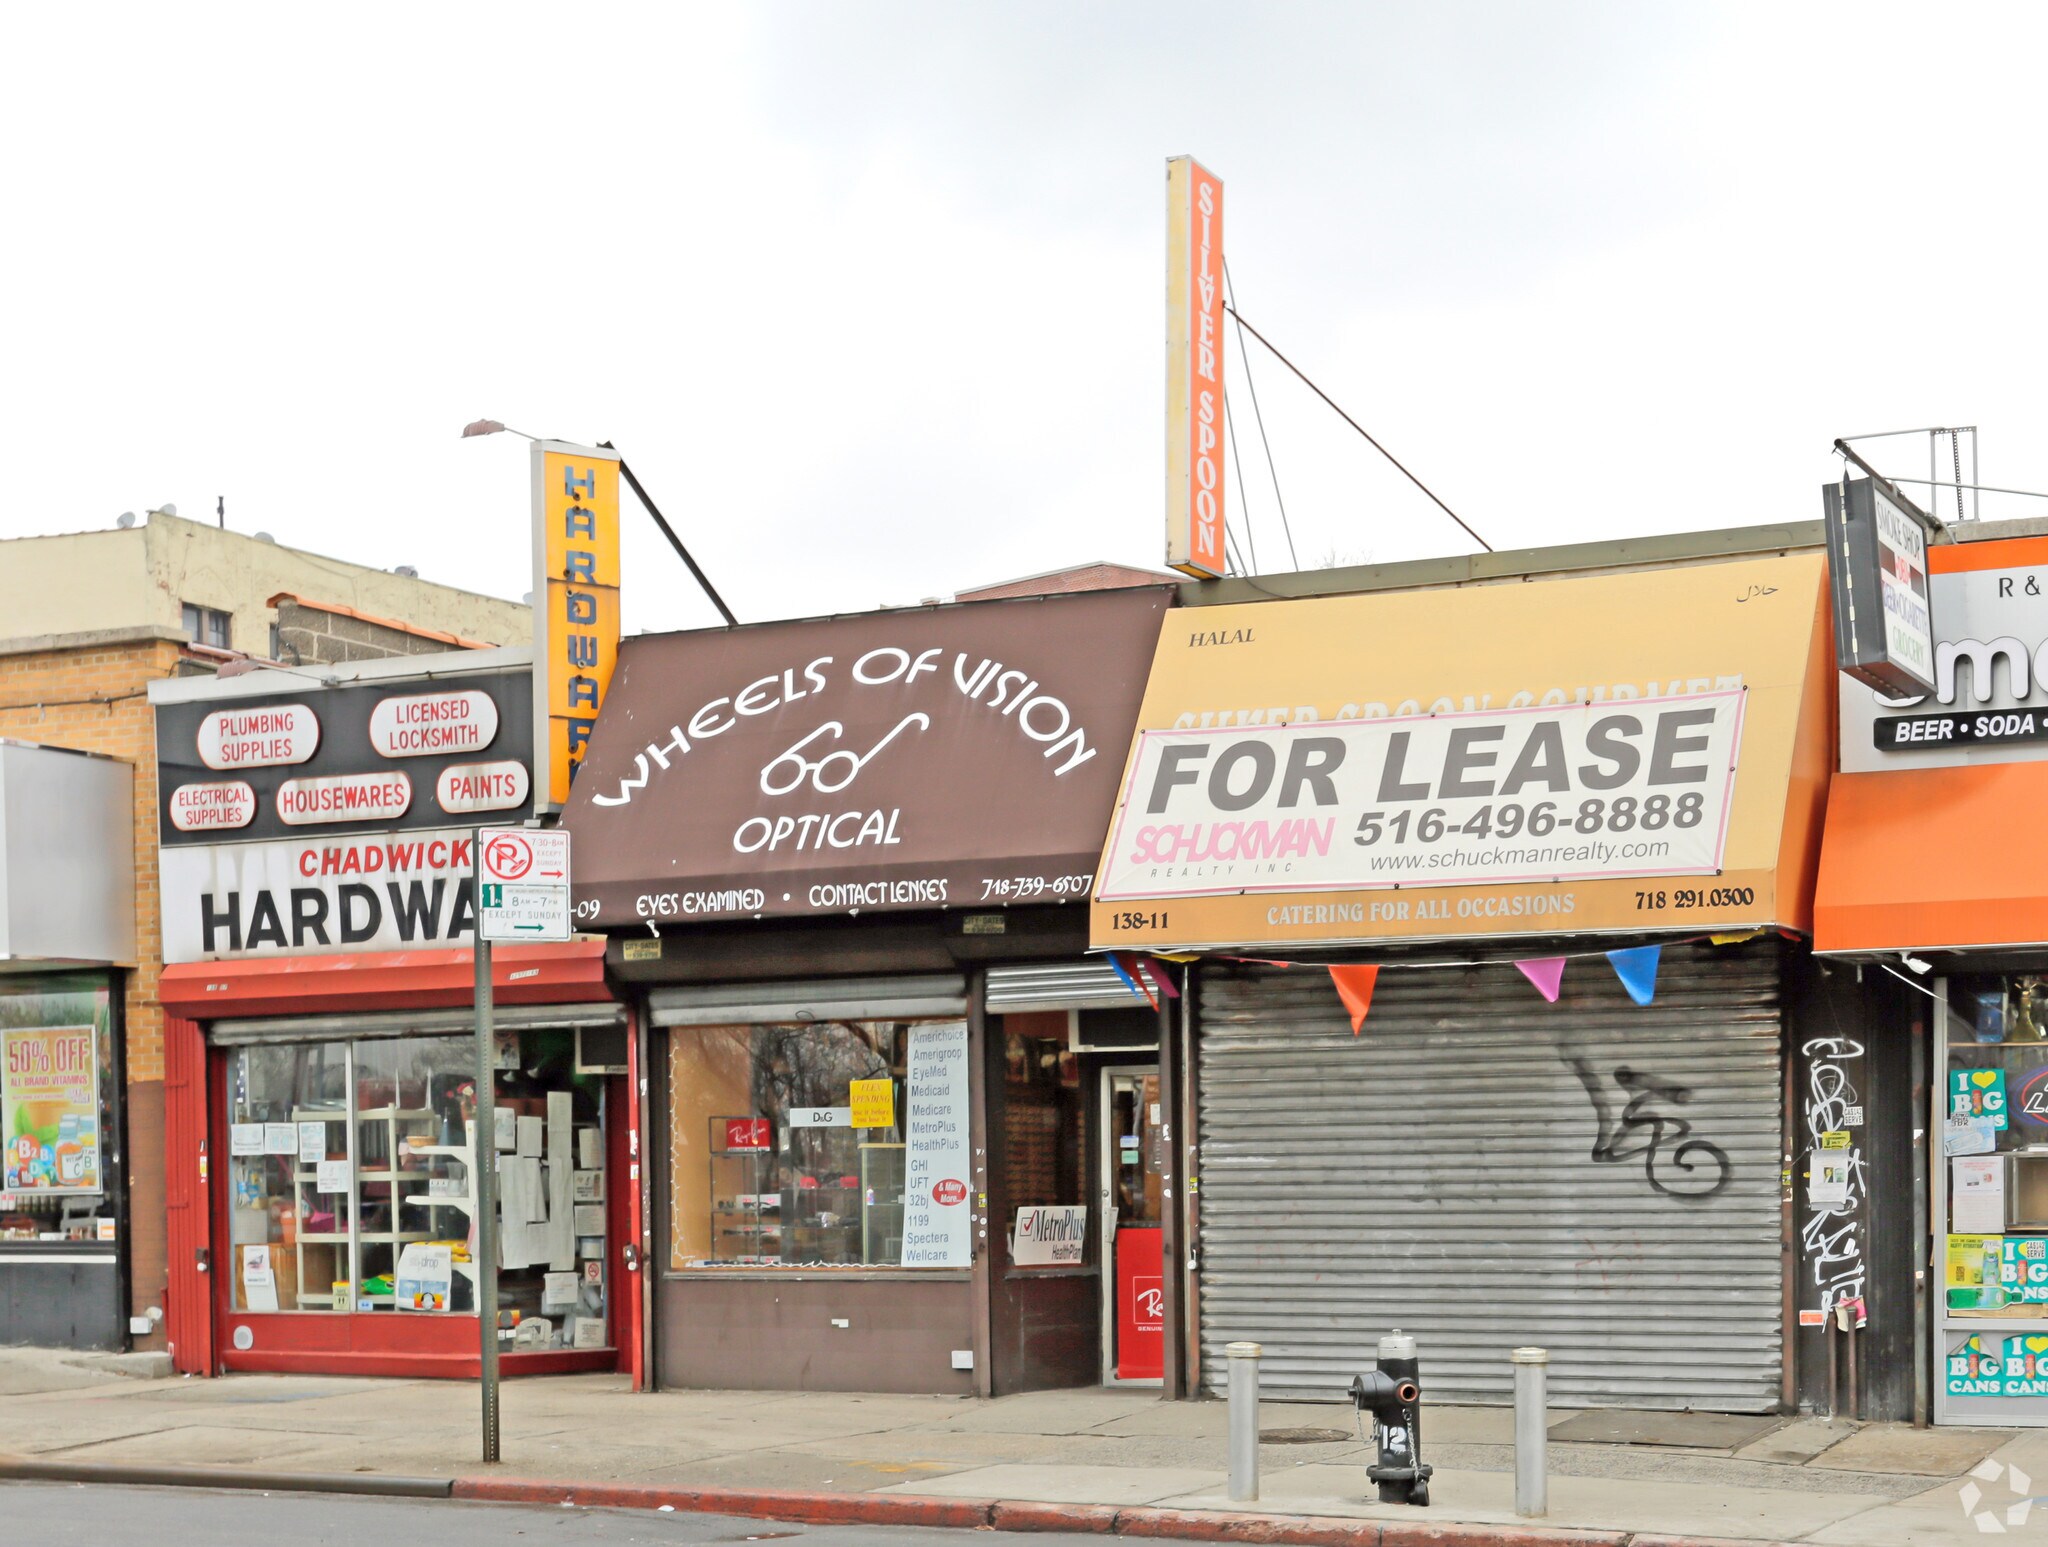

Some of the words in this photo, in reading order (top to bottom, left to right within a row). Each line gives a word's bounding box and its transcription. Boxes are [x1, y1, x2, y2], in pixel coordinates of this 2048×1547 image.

[1197, 181, 1216, 382] SILVER
[1197, 391, 1216, 557] SPOON
[1877, 502, 1902, 545] SMOKE
[1998, 577, 2013, 598] R
[2024, 575, 2041, 596] &
[564, 466, 598, 793] HARDWAR
[1188, 627, 1256, 649] HALAL
[396, 699, 470, 724] LICENSED
[219, 713, 295, 738] PLUMBING
[592, 656, 834, 807] WHEELS
[852, 647, 943, 685] OF
[953, 652, 1097, 777] VISION
[1895, 720, 1954, 743] BEER
[1974, 713, 2035, 738] SODA
[389, 724, 479, 751] LOCKSMITH
[221, 738, 293, 763] SUPPLIES
[1146, 736, 1347, 815] FOR
[1376, 707, 1718, 805] LEASE
[178, 787, 249, 808] ELECTRICAL
[449, 773, 517, 800] PAINTS
[283, 783, 406, 814] HOUSEWARES
[185, 807, 243, 825] SUPPLIES
[1353, 791, 1705, 847] 516-496-8888
[733, 808, 901, 854] OPTICAL
[1130, 816, 1336, 866] SCHUCKMAN
[299, 839, 472, 877] CHADWICK
[1369, 838, 1670, 872] www.schuckmanrealty.com
[1149, 865, 1237, 880] REALTY
[808, 882, 888, 907] CONTACT
[889, 878, 948, 904] LENSES
[980, 874, 1094, 901] 718-739-6507
[1635, 890, 1667, 911] 718
[1673, 887, 1755, 909] 291.0300
[200, 876, 475, 952] HARDWA
[636, 894, 679, 918] EYES
[682, 888, 765, 915] EXAMINED
[1267, 902, 1364, 926] CATERING
[1369, 901, 1401, 922] FOR
[1405, 898, 1452, 920] ALL
[1455, 892, 1576, 919] OCCASIONS
[489, 911, 522, 919] EXCEPT
[528, 911, 562, 920] SUNDAY
[1111, 911, 1170, 931] 138-11
[9, 1040, 49, 1073] 50%
[56, 1038, 88, 1072] OFF
[11, 1077, 21, 1087] ALL
[24, 1076, 49, 1087] BRAND
[52, 1074, 88, 1086] VITAMINS
[912, 1065, 947, 1080] EyeMed
[1957, 1072, 1970, 1092] I
[852, 1095, 890, 1104] SPENDING
[911, 1083, 950, 1097] Medicaid
[813, 1111, 834, 1123] D&G
[912, 1103, 952, 1117] Medicare
[912, 1120, 956, 1134] MetroPlus
[911, 1138, 960, 1152] HealthPlus
[910, 1159, 928, 1172] GHI
[910, 1176, 930, 1189] UFT
[909, 1194, 929, 1209] 32bj
[908, 1214, 930, 1227] 1199
[1033, 1208, 1085, 1243] MetroPlus
[907, 1231, 949, 1245] Spectera
[906, 1247, 948, 1261] Wellcare
[2004, 1242, 2016, 1261] I
[2012, 1336, 2023, 1355] I
[1949, 1380, 2000, 1394] CANS
[2005, 1380, 2048, 1393] CAN
